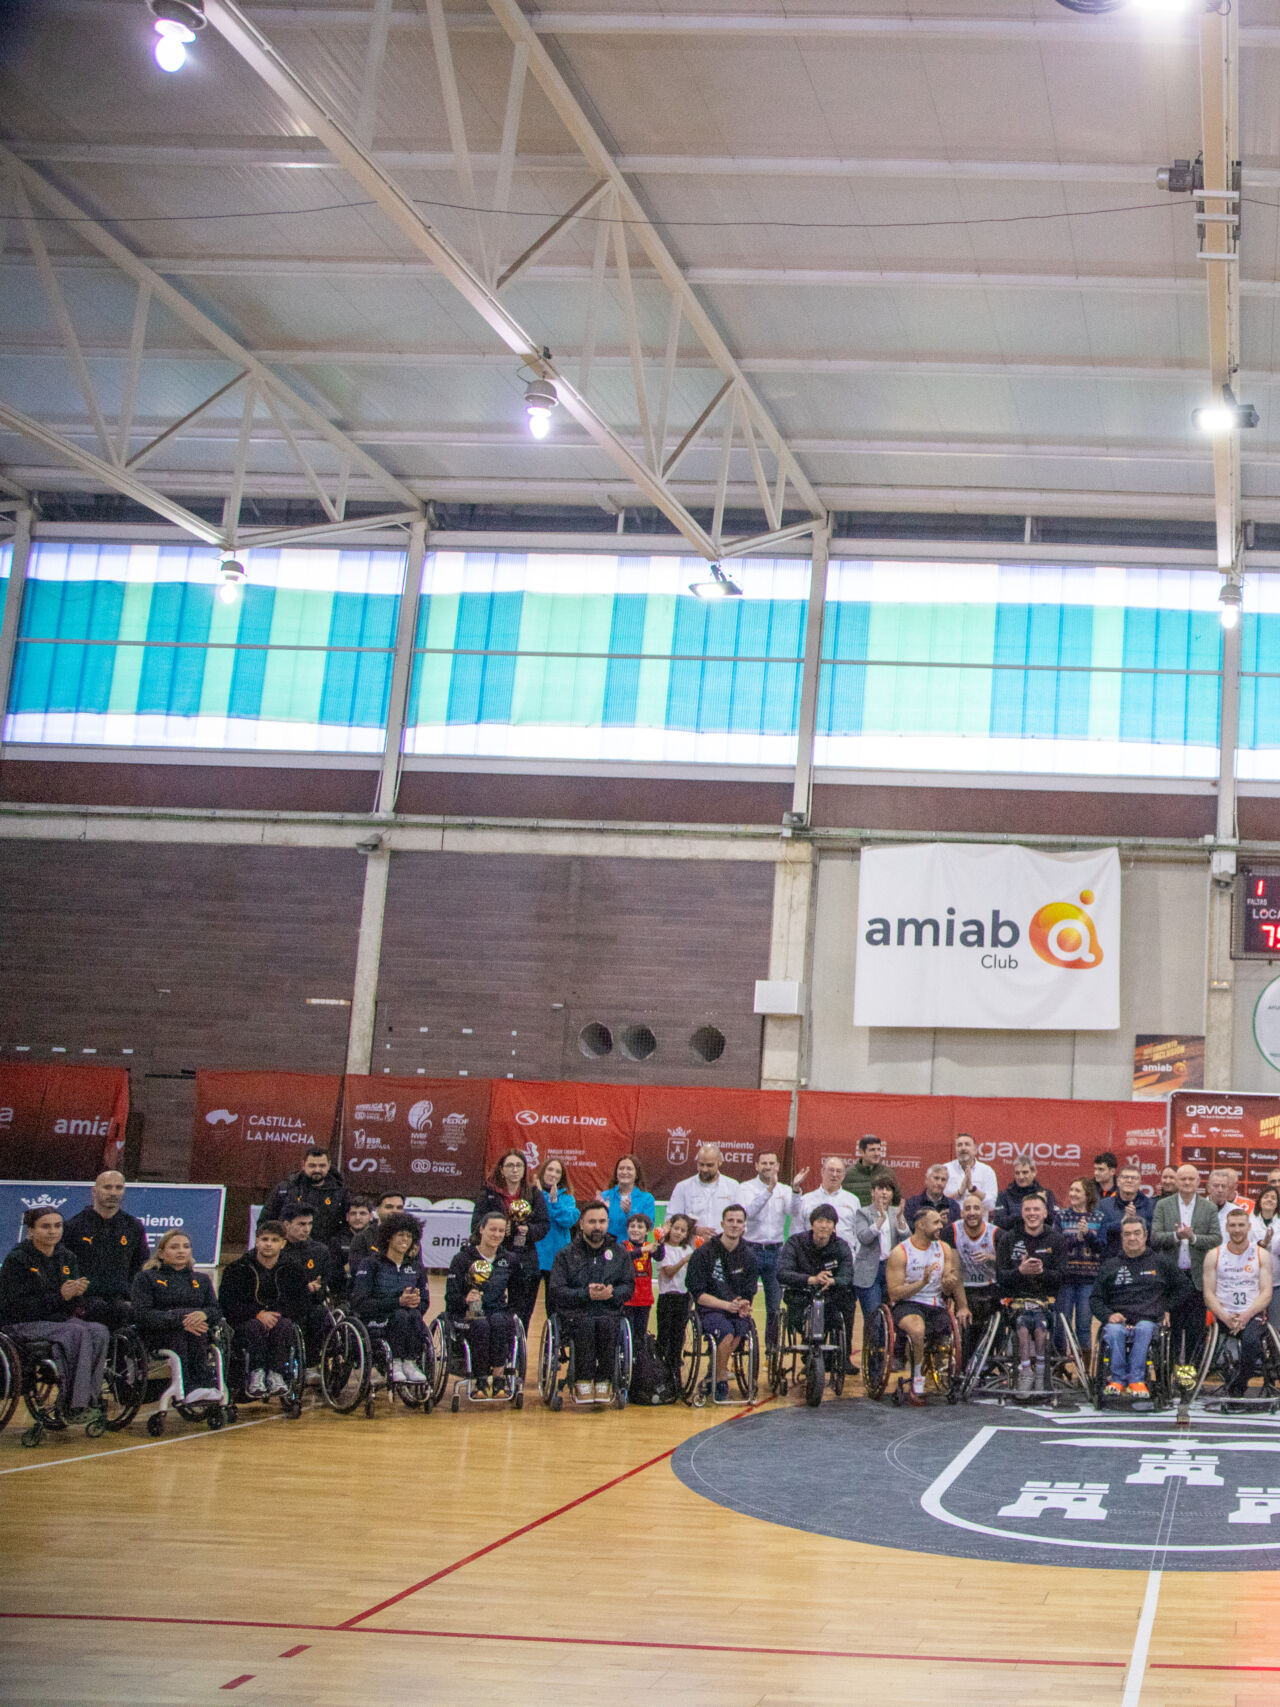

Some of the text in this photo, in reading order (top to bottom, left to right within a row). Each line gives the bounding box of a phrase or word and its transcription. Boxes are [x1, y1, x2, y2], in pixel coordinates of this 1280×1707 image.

[865, 907, 1020, 948] amiab
[981, 954, 1019, 969] Club
[1185, 1104, 1244, 1118] gaviota
[54, 1115, 114, 1136] amia
[249, 1115, 306, 1128] CASTILLA-
[541, 1114, 608, 1127] KING LONG
[246, 1130, 316, 1145] LA MANCHA
[977, 1141, 1081, 1161] gaviota
[432, 1166, 456, 1174] ONCE
[1233, 1292, 1247, 1305] 33
